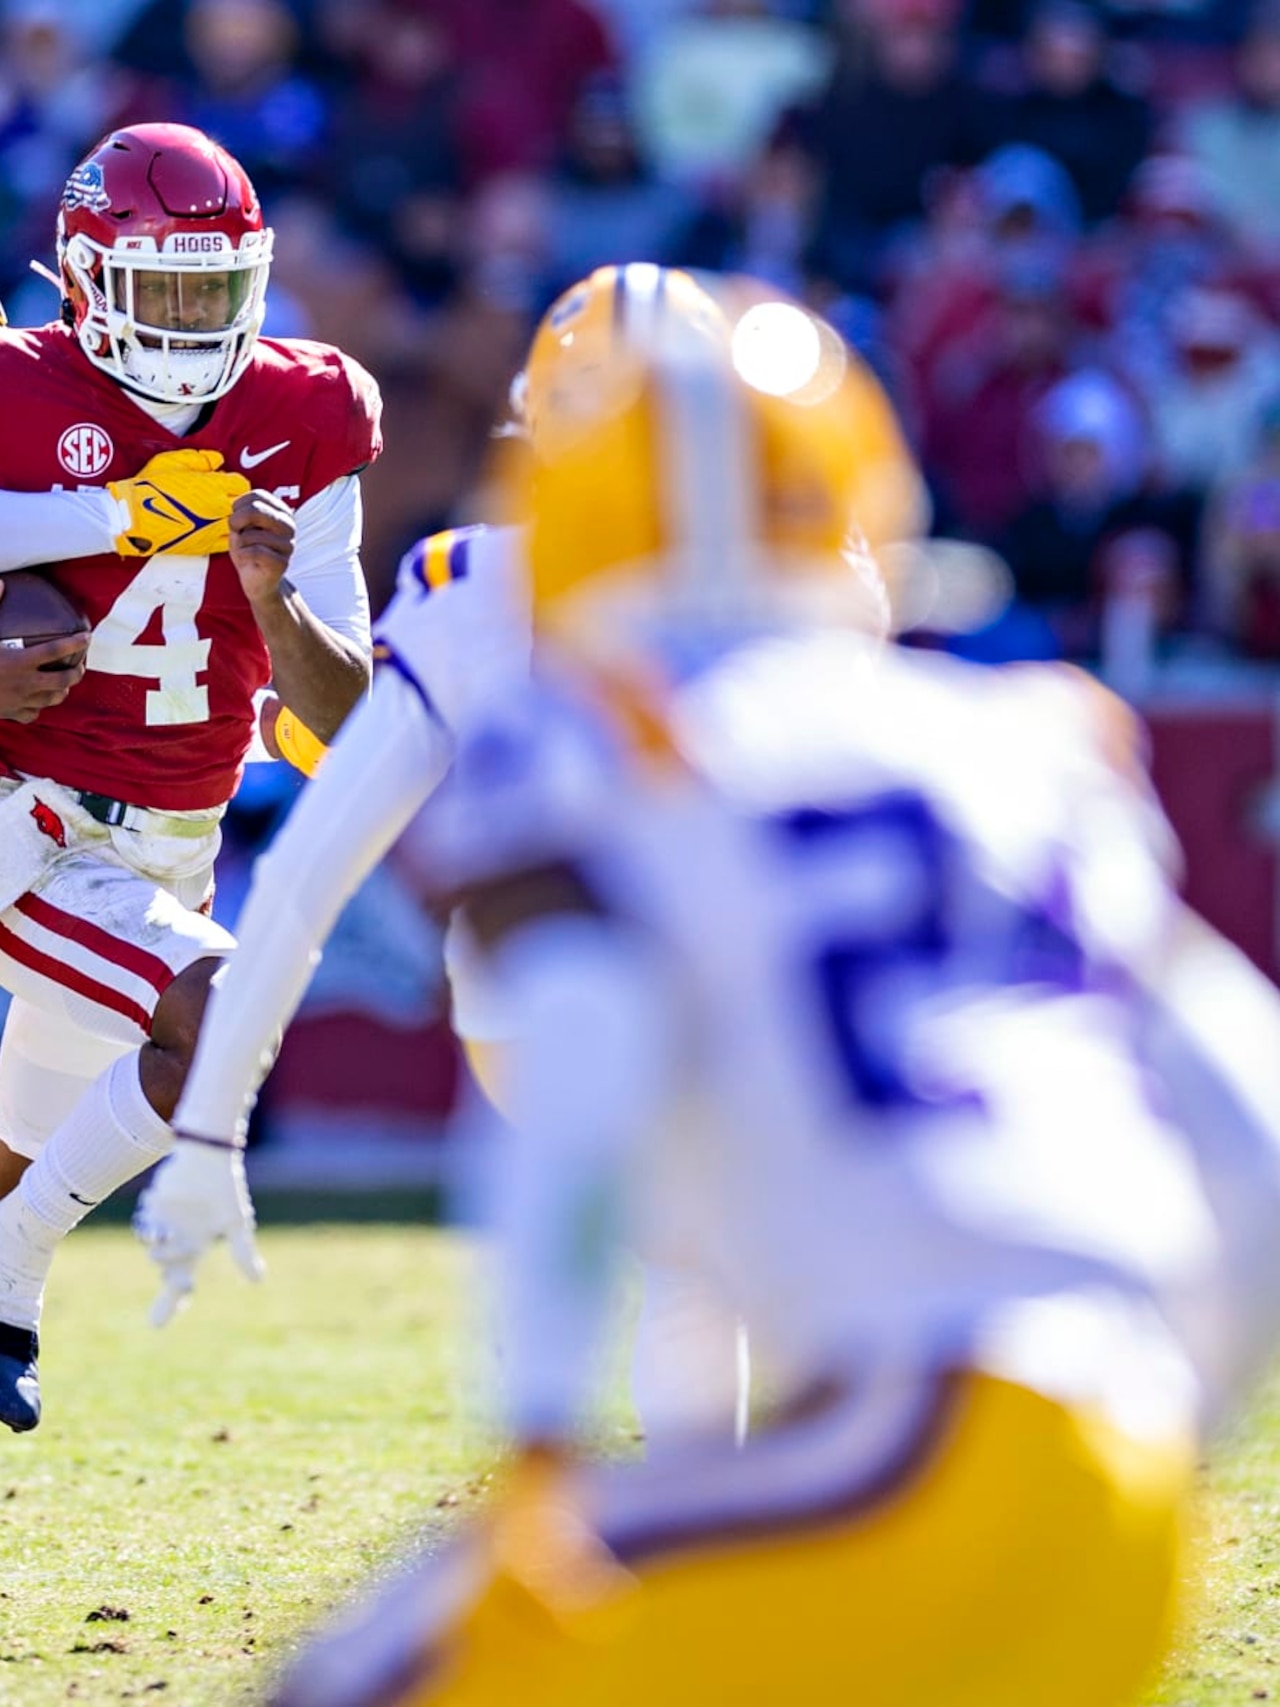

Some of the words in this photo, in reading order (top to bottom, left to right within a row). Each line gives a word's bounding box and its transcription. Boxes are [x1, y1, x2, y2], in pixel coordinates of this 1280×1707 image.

[175, 237, 223, 252] HOGS
[63, 427, 108, 475] SEC
[86, 555, 212, 725] 4
